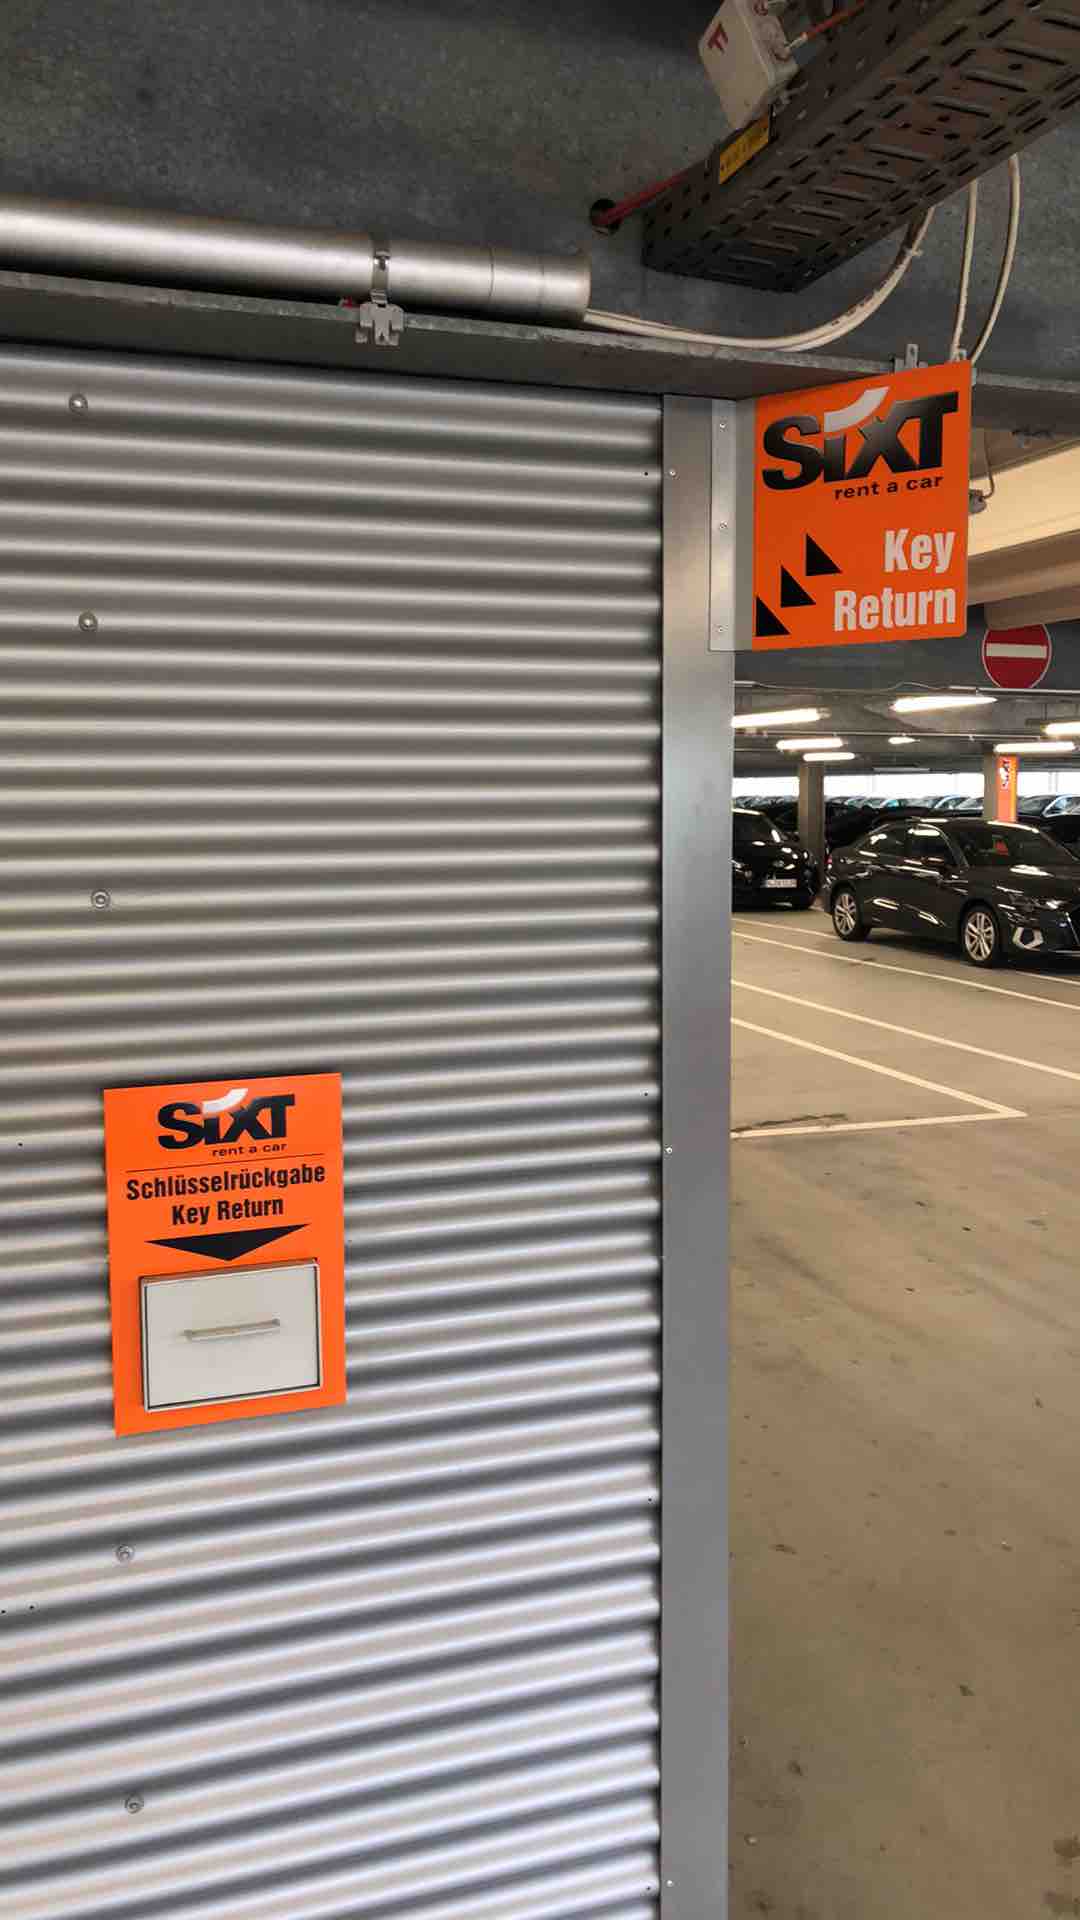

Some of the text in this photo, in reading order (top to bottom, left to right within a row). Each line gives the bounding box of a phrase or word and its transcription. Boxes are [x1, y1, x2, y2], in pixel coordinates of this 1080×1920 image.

[834, 474, 944, 500] rent a car
[883, 528, 956, 574] Key
[834, 587, 956, 632] Return
[212, 1143, 288, 1157] rent a car
[126, 1163, 326, 1201] Schlüsselrückgabe
[172, 1198, 284, 1226] Key Return
